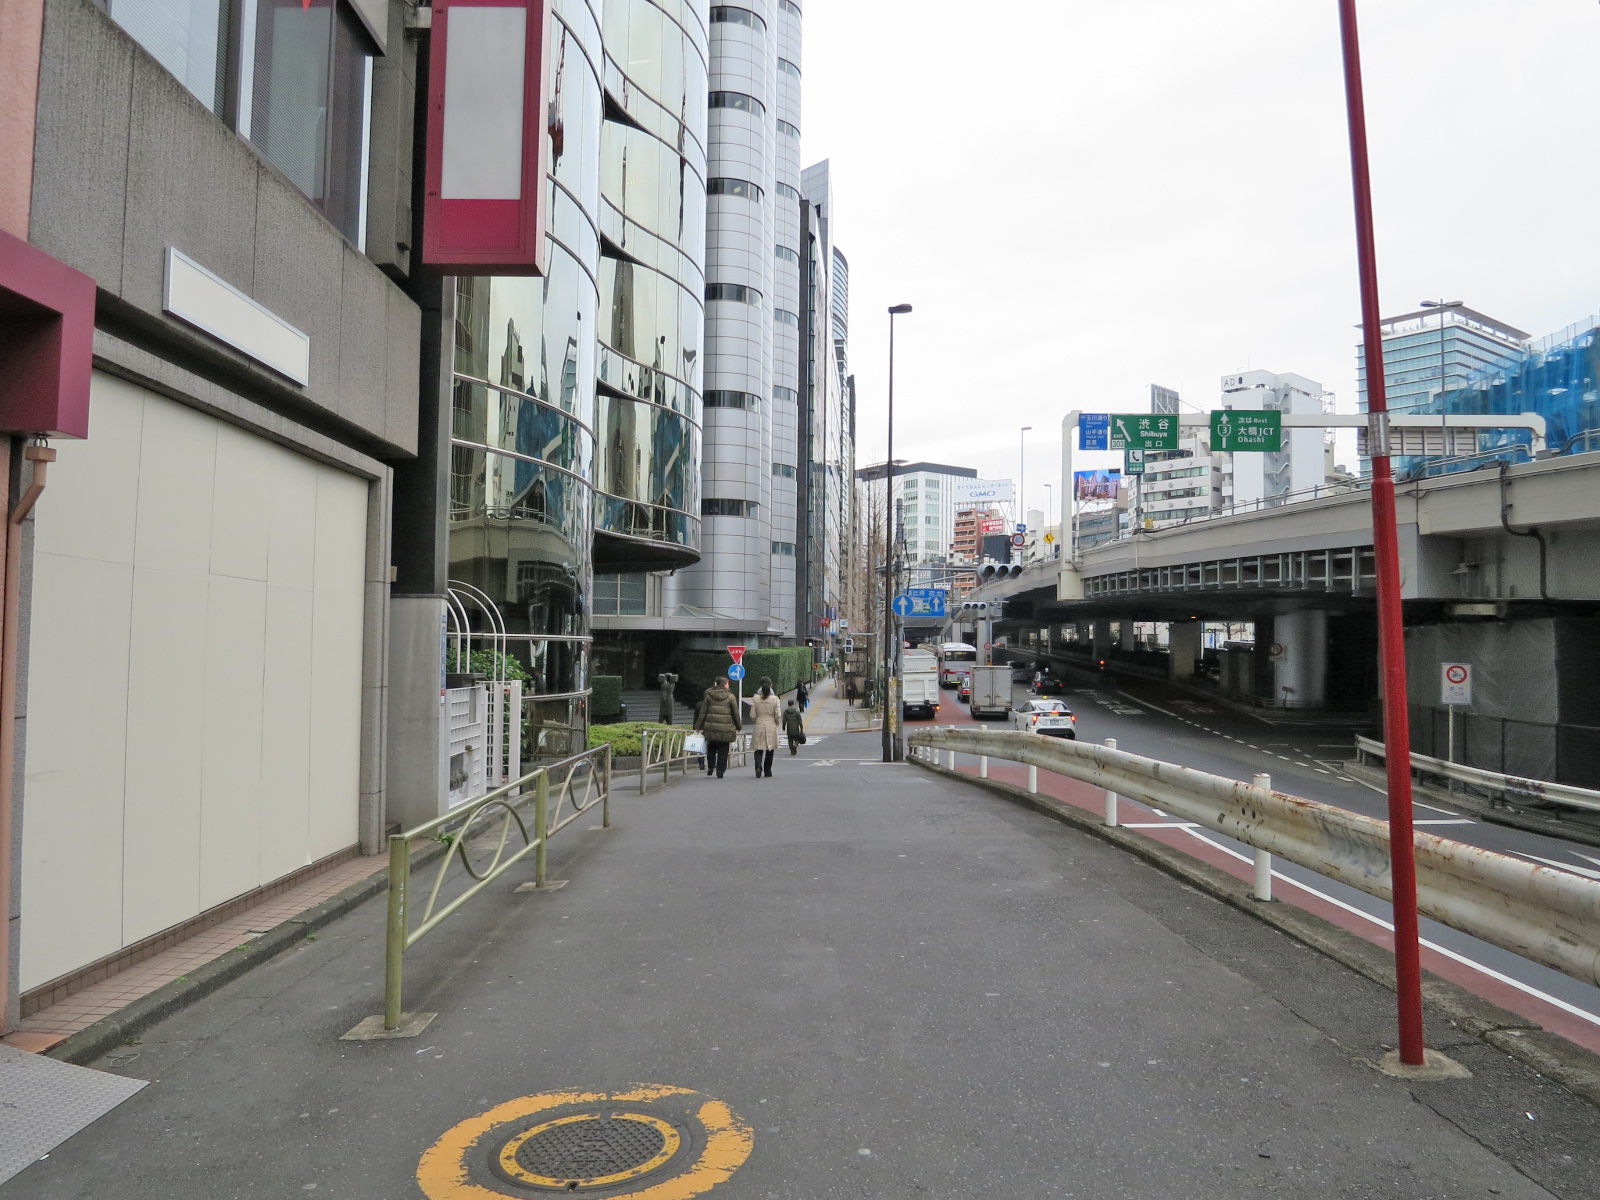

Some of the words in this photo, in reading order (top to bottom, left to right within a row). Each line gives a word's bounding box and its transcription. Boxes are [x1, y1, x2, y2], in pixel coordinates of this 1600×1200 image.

[1139, 419, 1169, 430] 渋谷
[1222, 426, 1228, 434] 3
[1112, 440, 1125, 448] 303
